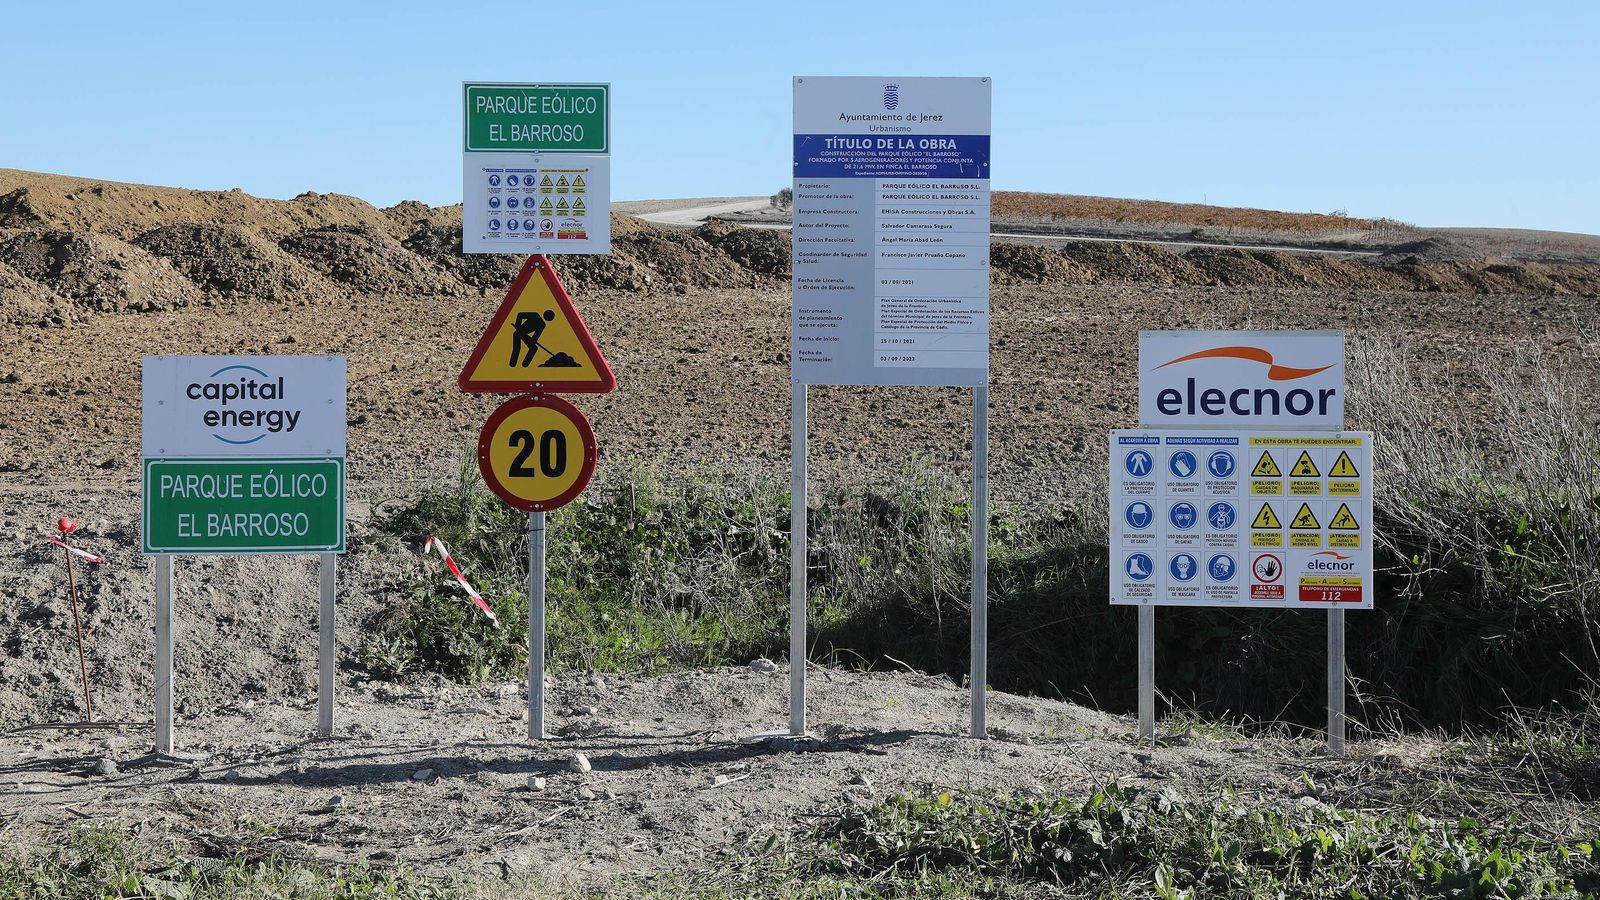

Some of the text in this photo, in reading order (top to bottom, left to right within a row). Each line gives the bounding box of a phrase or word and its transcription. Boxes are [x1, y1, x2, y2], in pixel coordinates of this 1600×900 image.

[476, 93, 596, 114] PARQUE EÓLICO
[839, 112, 902, 123] Ayuntamiento
[920, 112, 943, 123] Jerez
[490, 124, 584, 142] EL BARROSO
[825, 136, 957, 149] TÍTULO DE LA OBRA
[186, 377, 283, 405] capital
[1157, 378, 1335, 416] elecnor
[203, 409, 301, 433] energy
[508, 430, 566, 477] 20
[160, 469, 327, 499] PARQUE EÓLICO
[178, 512, 308, 537] EL BARROSO
[1308, 560, 1354, 570] elecnor
[1321, 592, 1341, 600] 112
